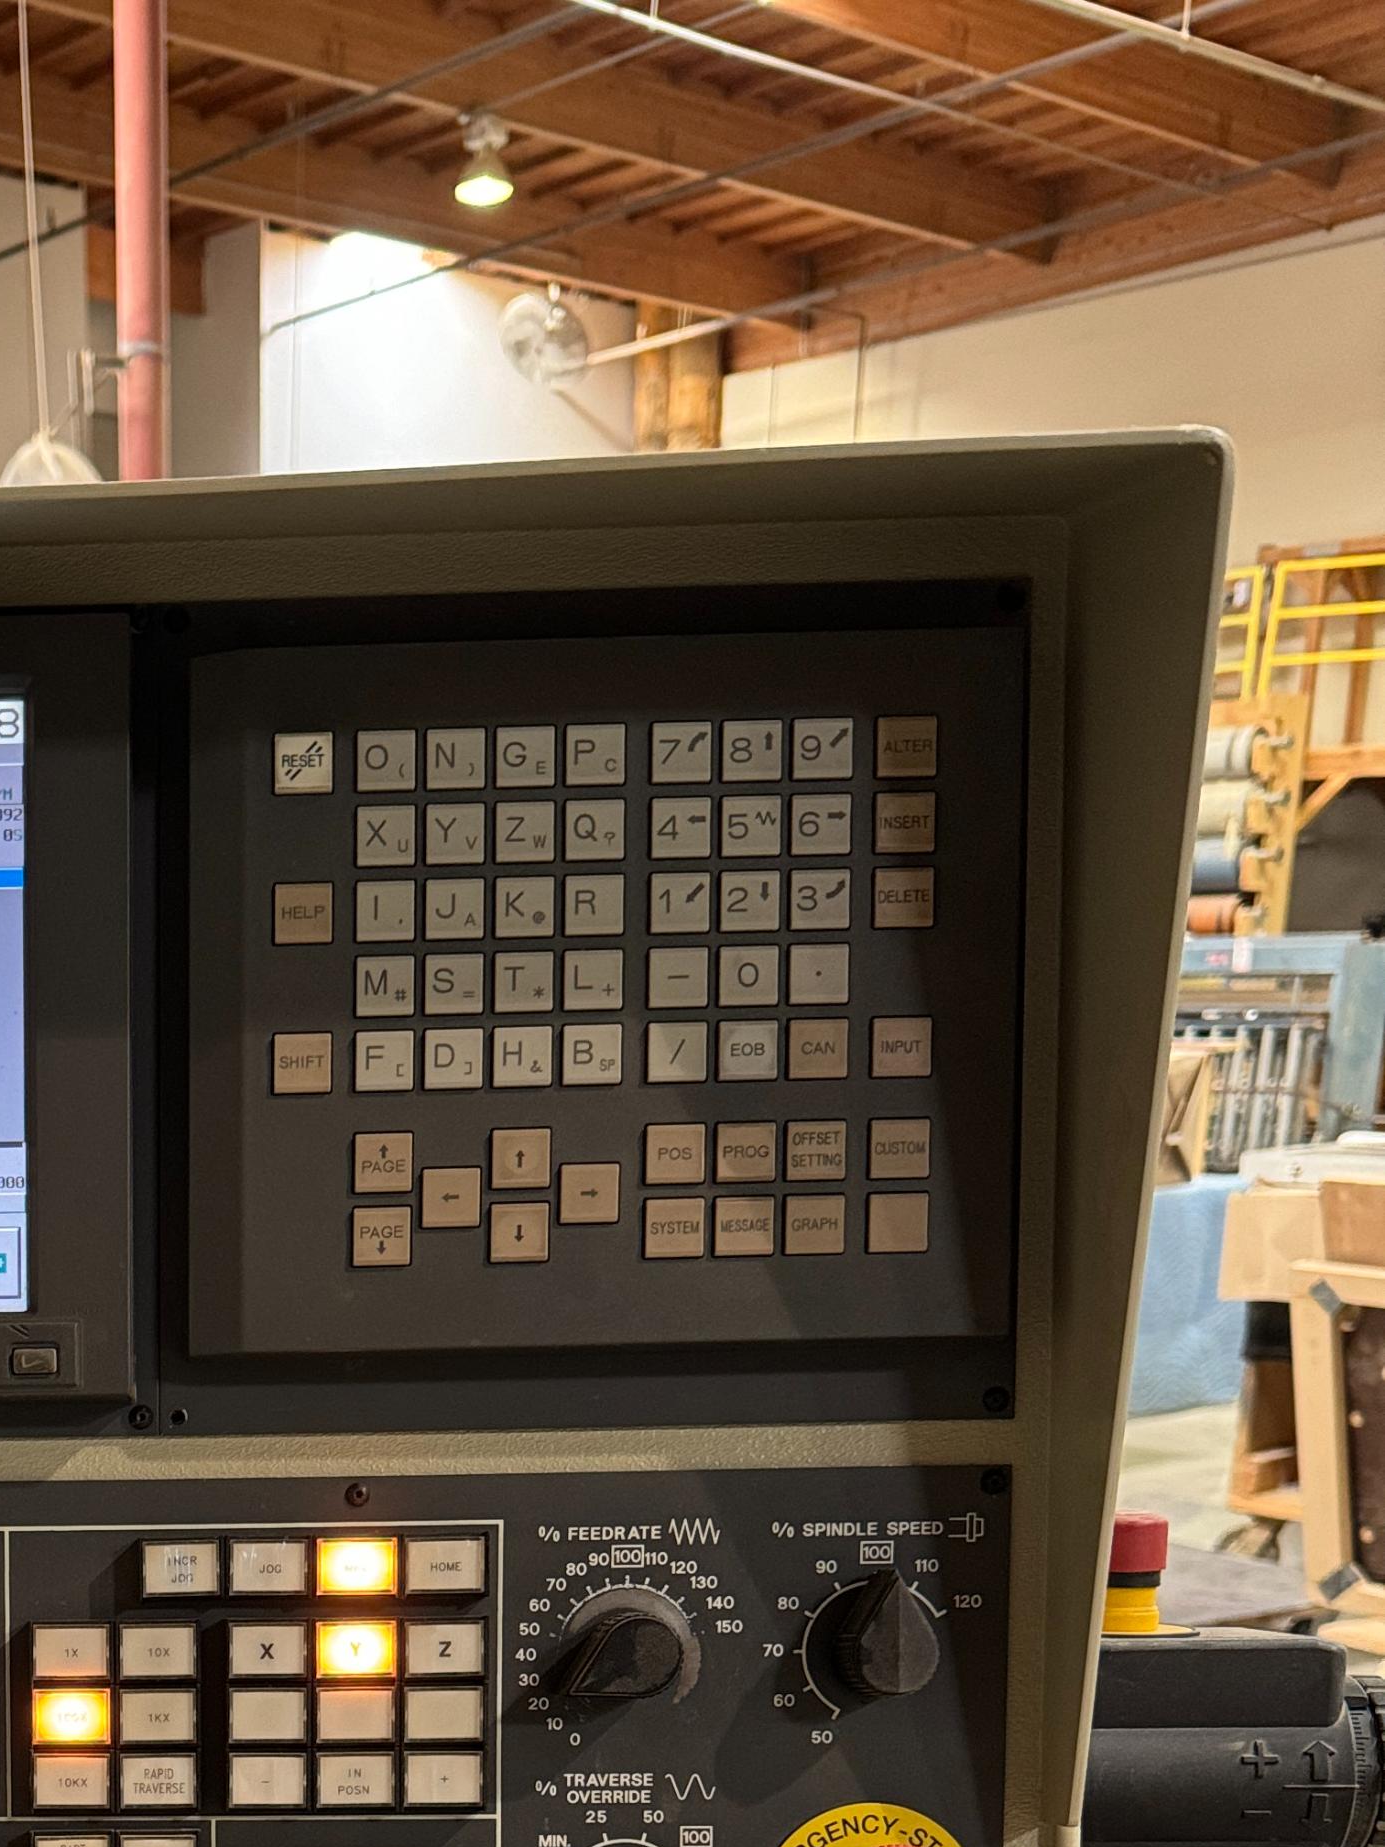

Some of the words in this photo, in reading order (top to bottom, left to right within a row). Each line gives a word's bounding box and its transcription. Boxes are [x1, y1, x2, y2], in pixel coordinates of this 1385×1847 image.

[883, 739, 933, 753] ALTER
[282, 754, 324, 768] RESET
[879, 815, 930, 829] INSERT
[878, 889, 930, 903] DELETE
[282, 906, 325, 920] HELP
[730, 1043, 765, 1057] EOB
[801, 1041, 835, 1055] CAN
[880, 1040, 922, 1054] INPUT
[279, 1055, 325, 1069] SHIFT
[793, 1131, 840, 1146] OFFSET
[658, 1147, 692, 1160] POS
[723, 1146, 769, 1159] PROG
[875, 1141, 926, 1155] CUSTOM
[361, 1160, 406, 1173] PAGE
[791, 1153, 842, 1168] SETTING
[650, 1222, 700, 1235] SYSTEM
[721, 1219, 769, 1233] MESSAGE
[792, 1218, 838, 1231] GRAPH
[360, 1226, 404, 1239] PAGE
[568, 1525, 662, 1541] FEEDRATE
[802, 1521, 878, 1537] SPINDLE
[886, 1520, 943, 1536] SPEED
[614, 1548, 641, 1564] 100
[862, 1544, 890, 1560] 100
[167, 1555, 197, 1568] INCR
[259, 1562, 282, 1575] JOG
[430, 1561, 462, 1572] HOME
[815, 1560, 837, 1574] 90
[777, 1595, 799, 1611] 80
[953, 1594, 982, 1609] 120
[519, 1622, 540, 1637] 50
[716, 1619, 743, 1633] 150
[147, 1647, 171, 1658] 10X
[260, 1642, 275, 1660] X
[438, 1641, 452, 1658] Z
[144, 1768, 174, 1780] RAPID
[347, 1768, 361, 1778] IN
[57, 1777, 88, 1788] 10KX
[564, 1773, 654, 1788] TRAVERSE
[133, 1782, 186, 1795] TRAVERSE
[337, 1785, 370, 1796] POSN
[566, 1789, 651, 1805] OVERRIDE
[538, 1834, 571, 1847] MIN.
[683, 1830, 710, 1845] 100
